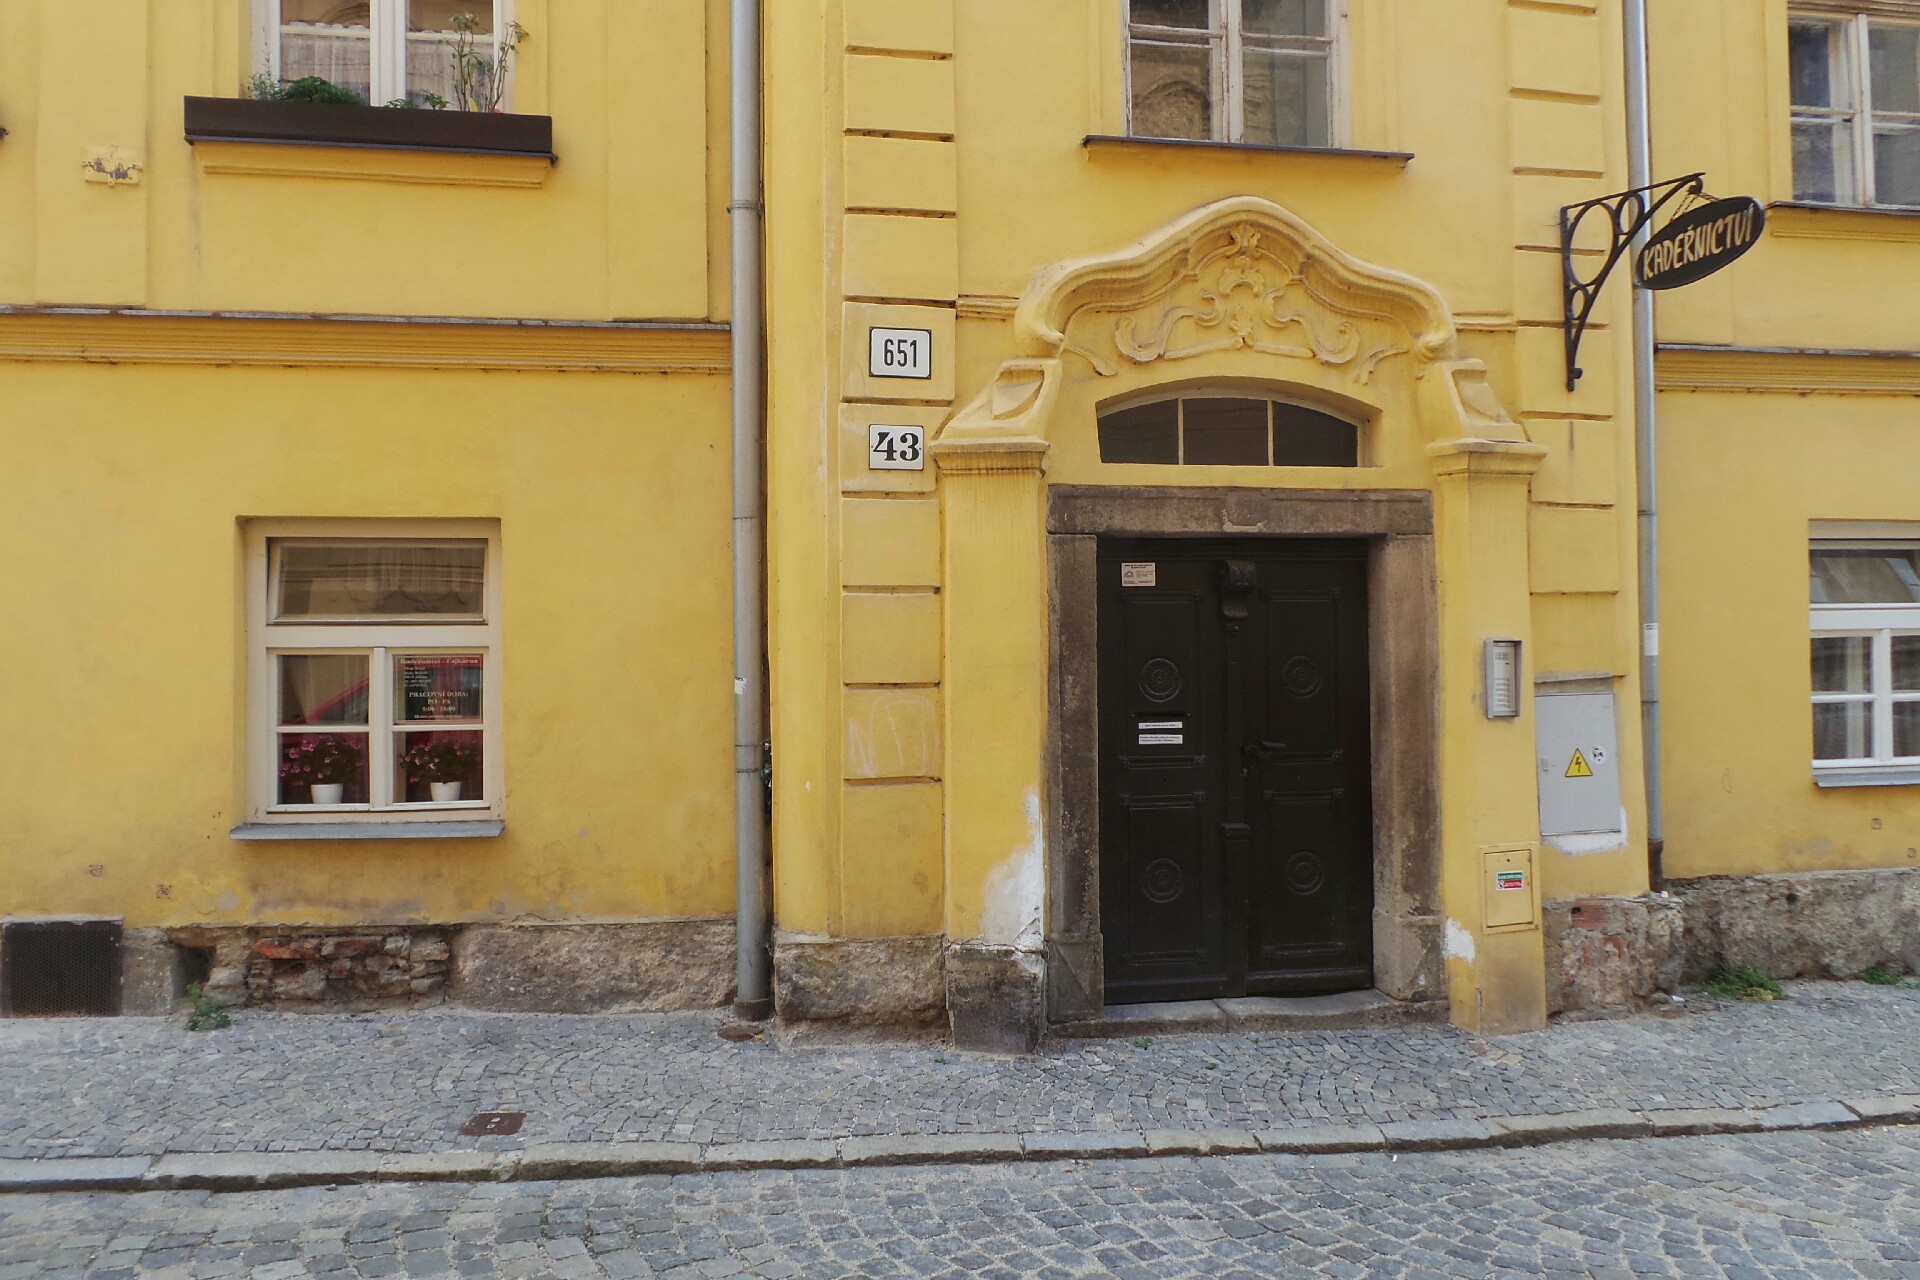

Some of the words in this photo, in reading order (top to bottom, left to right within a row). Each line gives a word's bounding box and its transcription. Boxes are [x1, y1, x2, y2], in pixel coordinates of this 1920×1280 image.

[1643, 202, 1754, 281] KADEŘNICTVÍ
[884, 338, 917, 368] 651
[872, 431, 920, 462] 43
